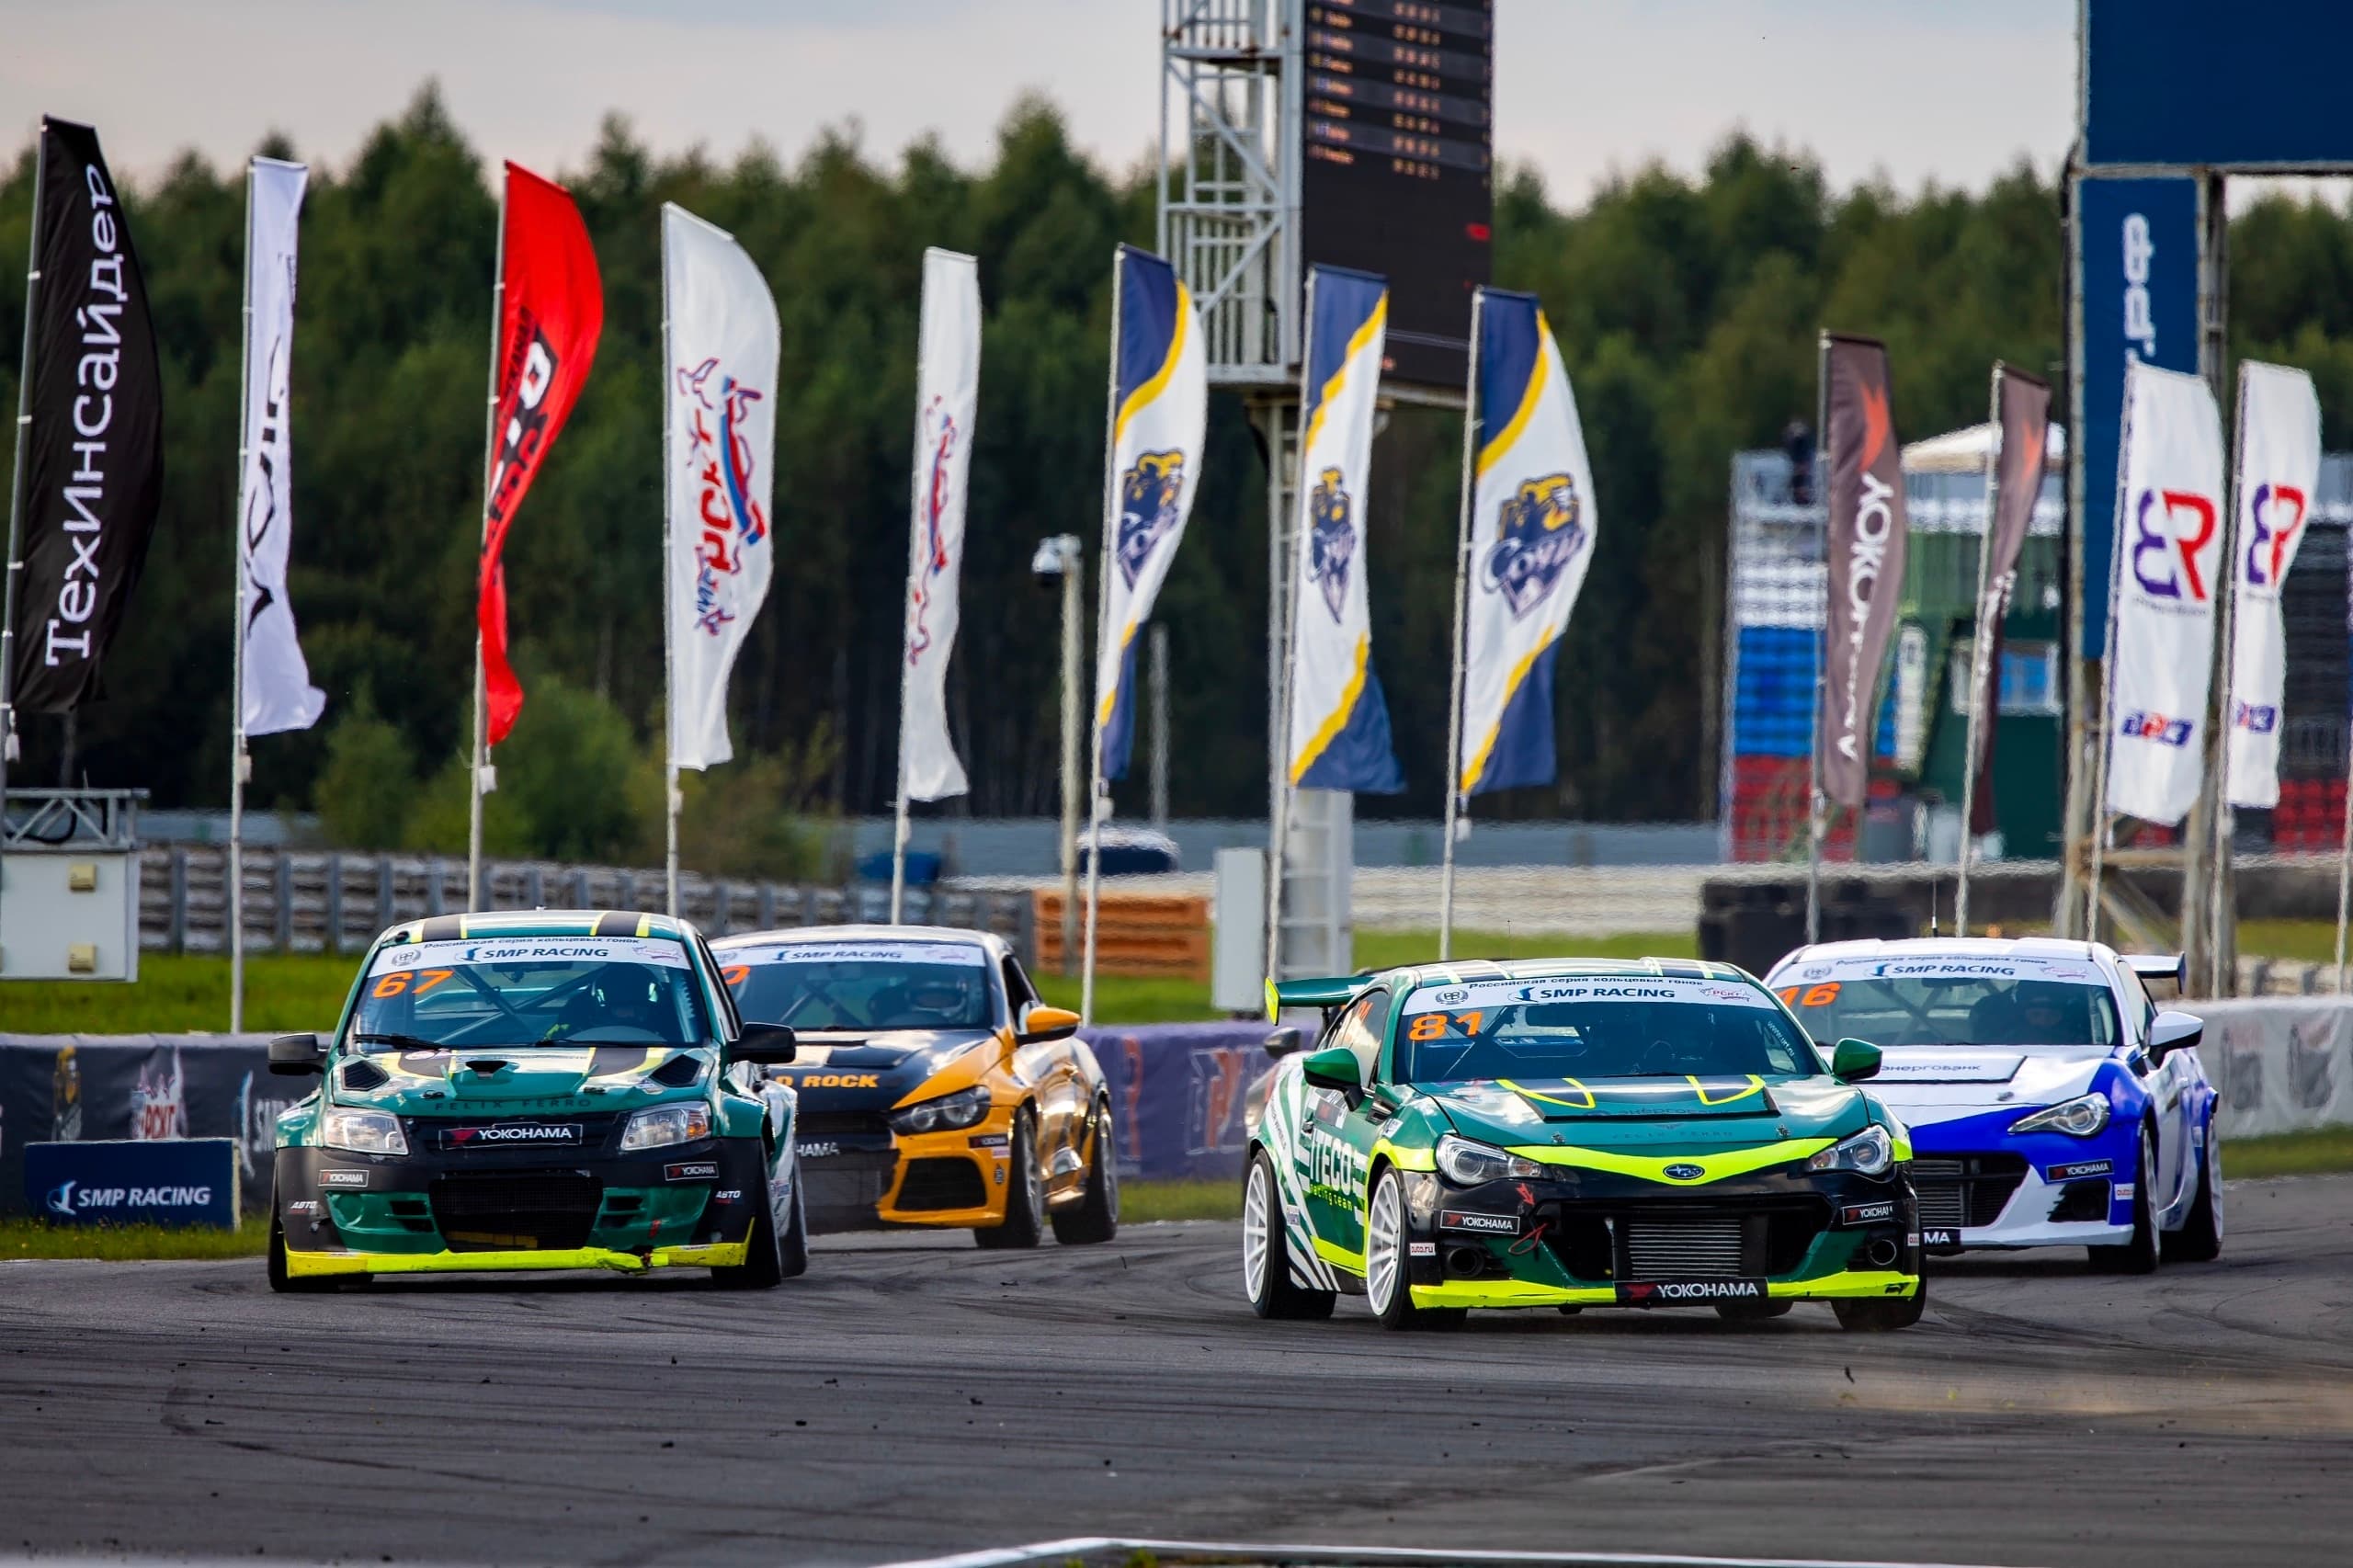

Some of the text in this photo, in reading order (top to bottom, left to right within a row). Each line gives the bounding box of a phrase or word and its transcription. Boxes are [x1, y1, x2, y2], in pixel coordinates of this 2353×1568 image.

[45, 164, 128, 665] ТехИнсайдер
[483, 947, 609, 959] SMP RACING
[791, 950, 904, 960] SMP RACING
[1893, 964, 2016, 976] SMP RACING
[372, 970, 455, 999] 67
[1469, 979, 1540, 990] Российская
[1540, 987, 1676, 999] SMP RACING
[1408, 1011, 1485, 1042] 81
[802, 1074, 880, 1087] ROCK
[478, 1127, 573, 1141] YOKOHAMA
[2065, 1162, 2109, 1176] YOKOHAMA
[77, 1187, 211, 1207] SMP RACING
[1461, 1216, 1513, 1230] YOKOHAMA
[1657, 1282, 1759, 1298] YOKOHAMA
